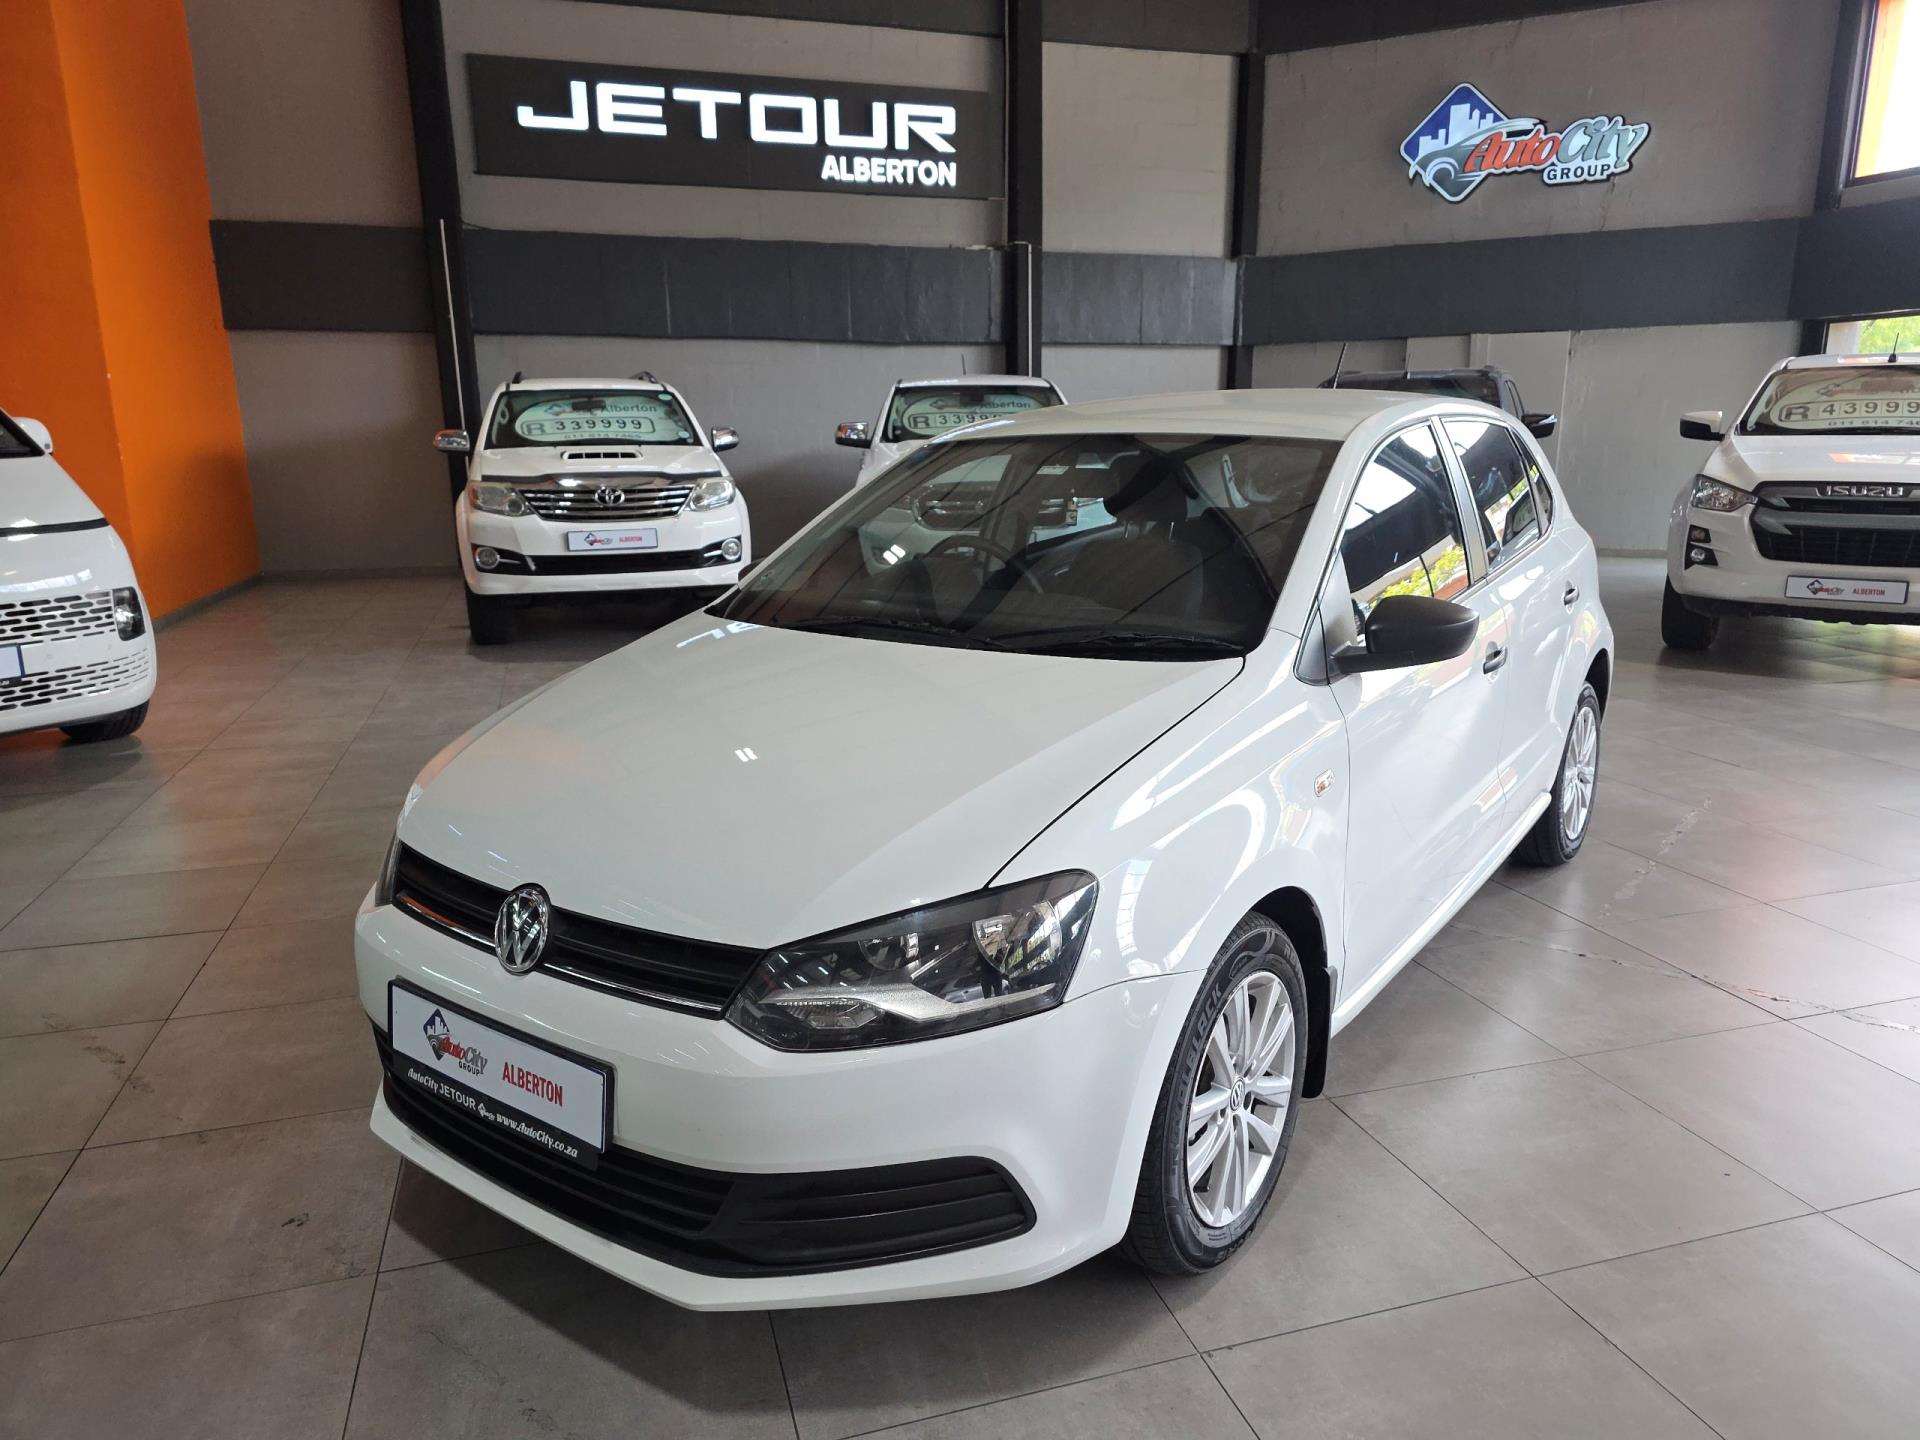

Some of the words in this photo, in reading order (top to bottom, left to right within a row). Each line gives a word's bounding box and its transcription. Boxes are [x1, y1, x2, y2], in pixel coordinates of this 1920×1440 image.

[517, 80, 956, 152] JETOUR
[1464, 117, 1645, 173] AutoCity
[821, 155, 956, 187] ALBERTON
[1547, 163, 1611, 181] GROUP
[555, 418, 642, 431] 339999
[1825, 485, 1903, 497] ISUZU
[441, 1036, 488, 1075] AutoCity
[458, 1060, 480, 1076] GROUP
[503, 1062, 562, 1107] ALBERTON
[407, 1068, 439, 1093] AutoCity
[440, 1083, 476, 1110] JETOUR
[496, 1113, 578, 1158] www.AutoCity.co.za
